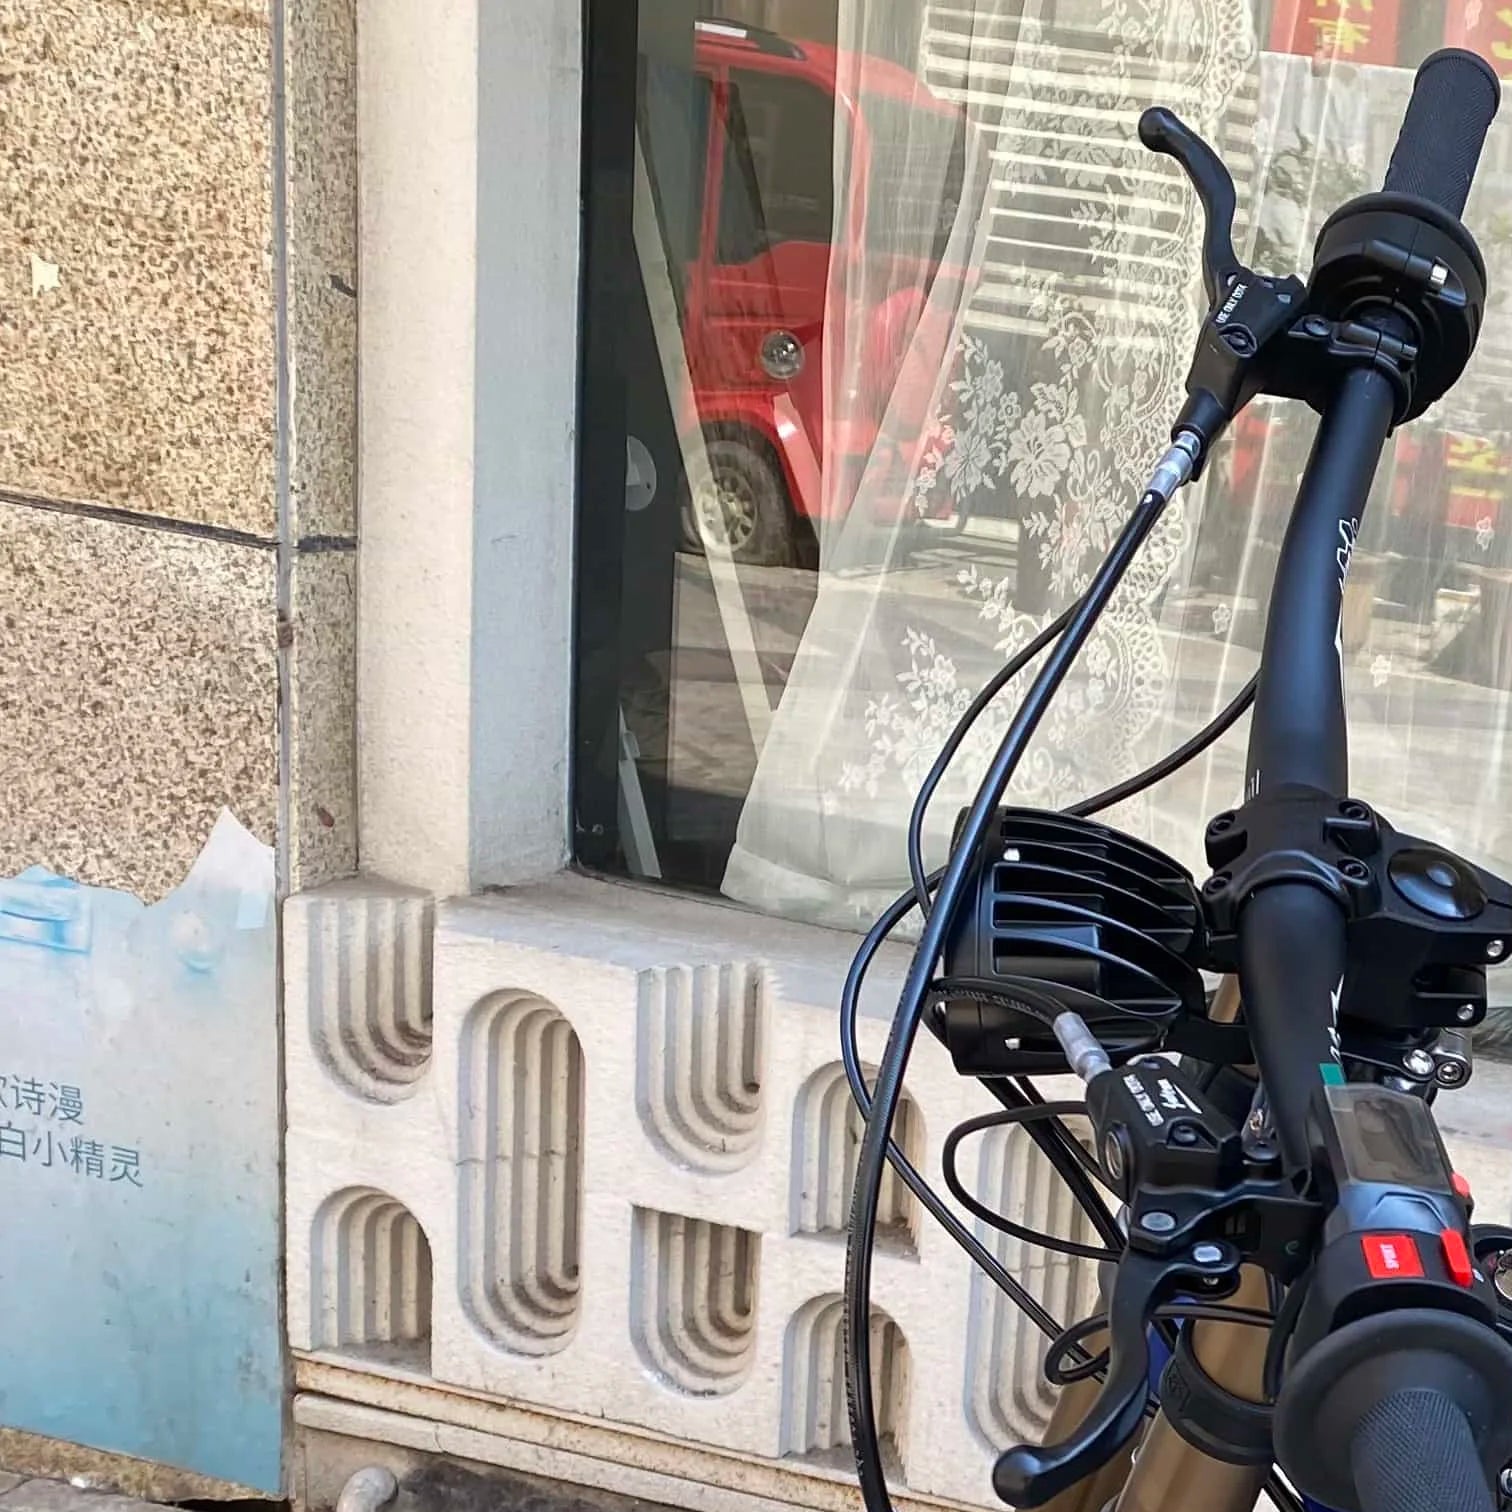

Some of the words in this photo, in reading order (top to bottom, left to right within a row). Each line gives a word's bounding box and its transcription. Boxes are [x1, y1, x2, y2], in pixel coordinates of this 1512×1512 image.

[0, 1074, 84, 1126] 诗漫
[0, 1120, 144, 1188] 白小精灵
